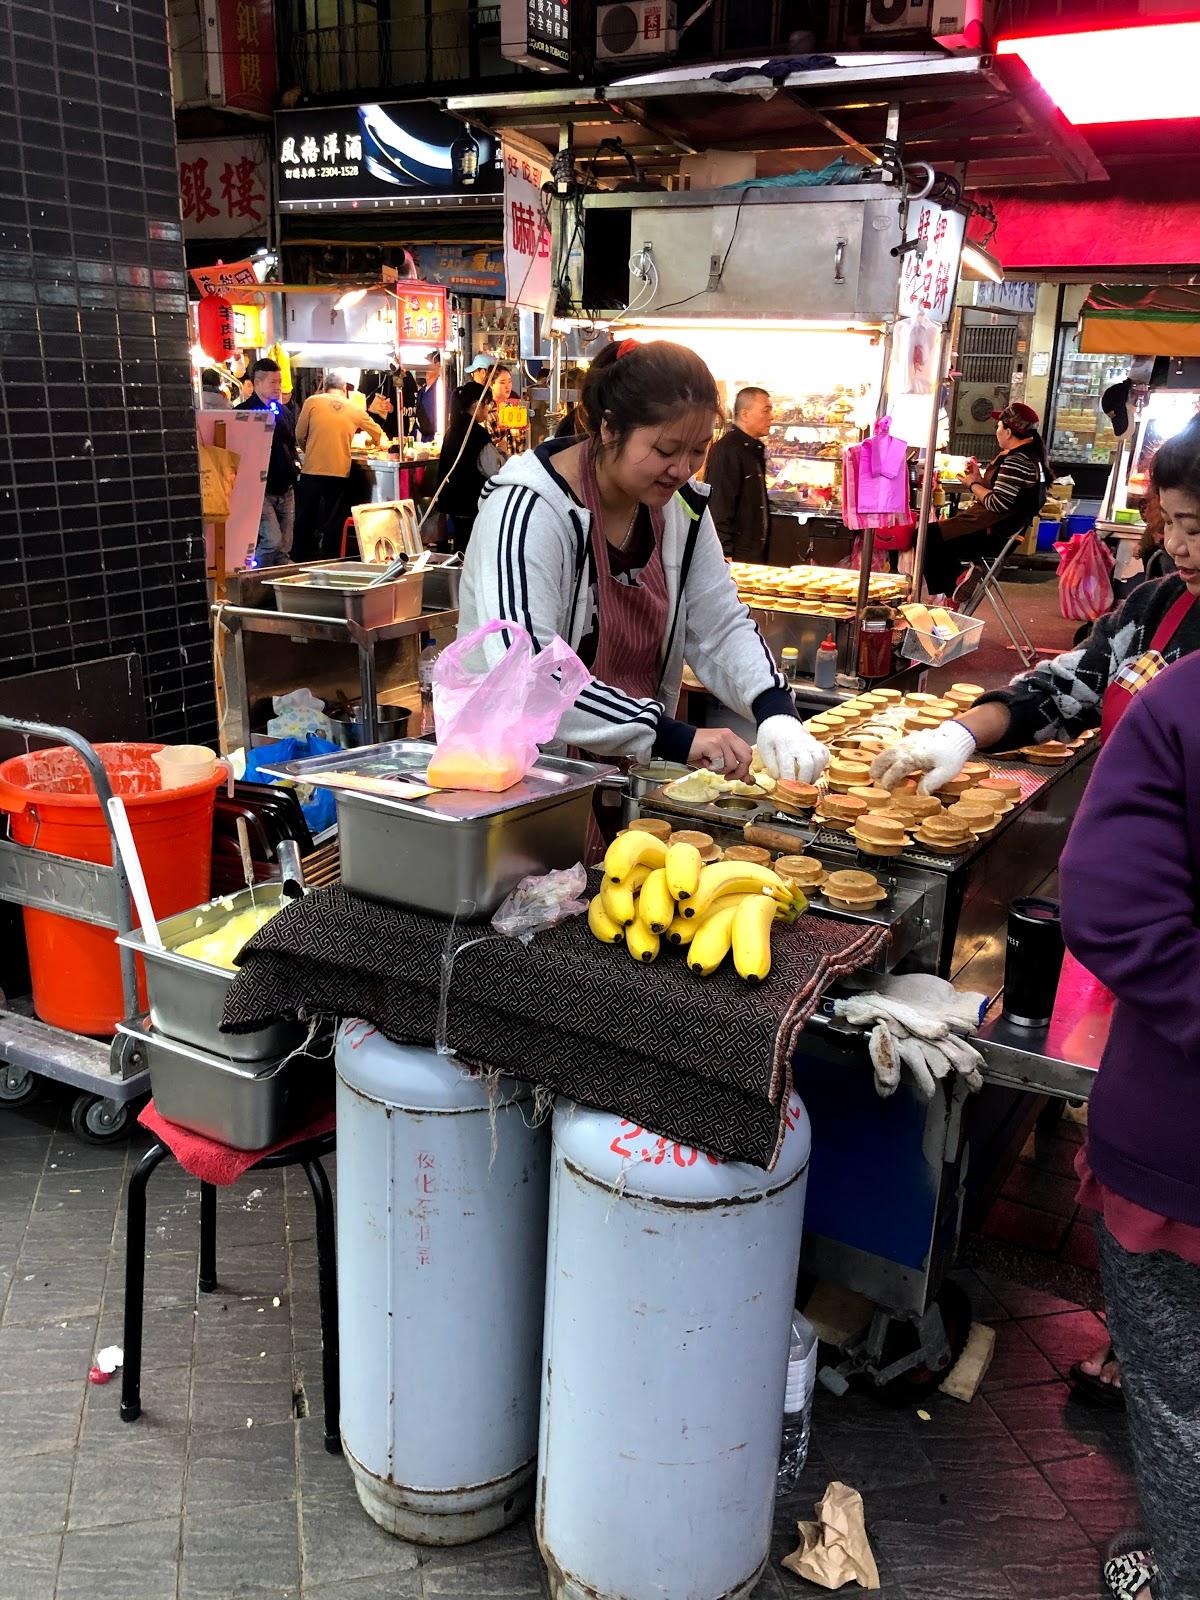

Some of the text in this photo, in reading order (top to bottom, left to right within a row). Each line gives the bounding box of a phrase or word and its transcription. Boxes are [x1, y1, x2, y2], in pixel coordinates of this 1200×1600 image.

[236, 1, 263, 95] 銀樓
[549, 46, 569, 61] TOBACCO
[281, 133, 362, 164] 風格洋酒
[507, 154, 542, 190] 好吃到
[180, 156, 265, 223] 銀樓
[403, 315, 441, 337] 羊肉串
